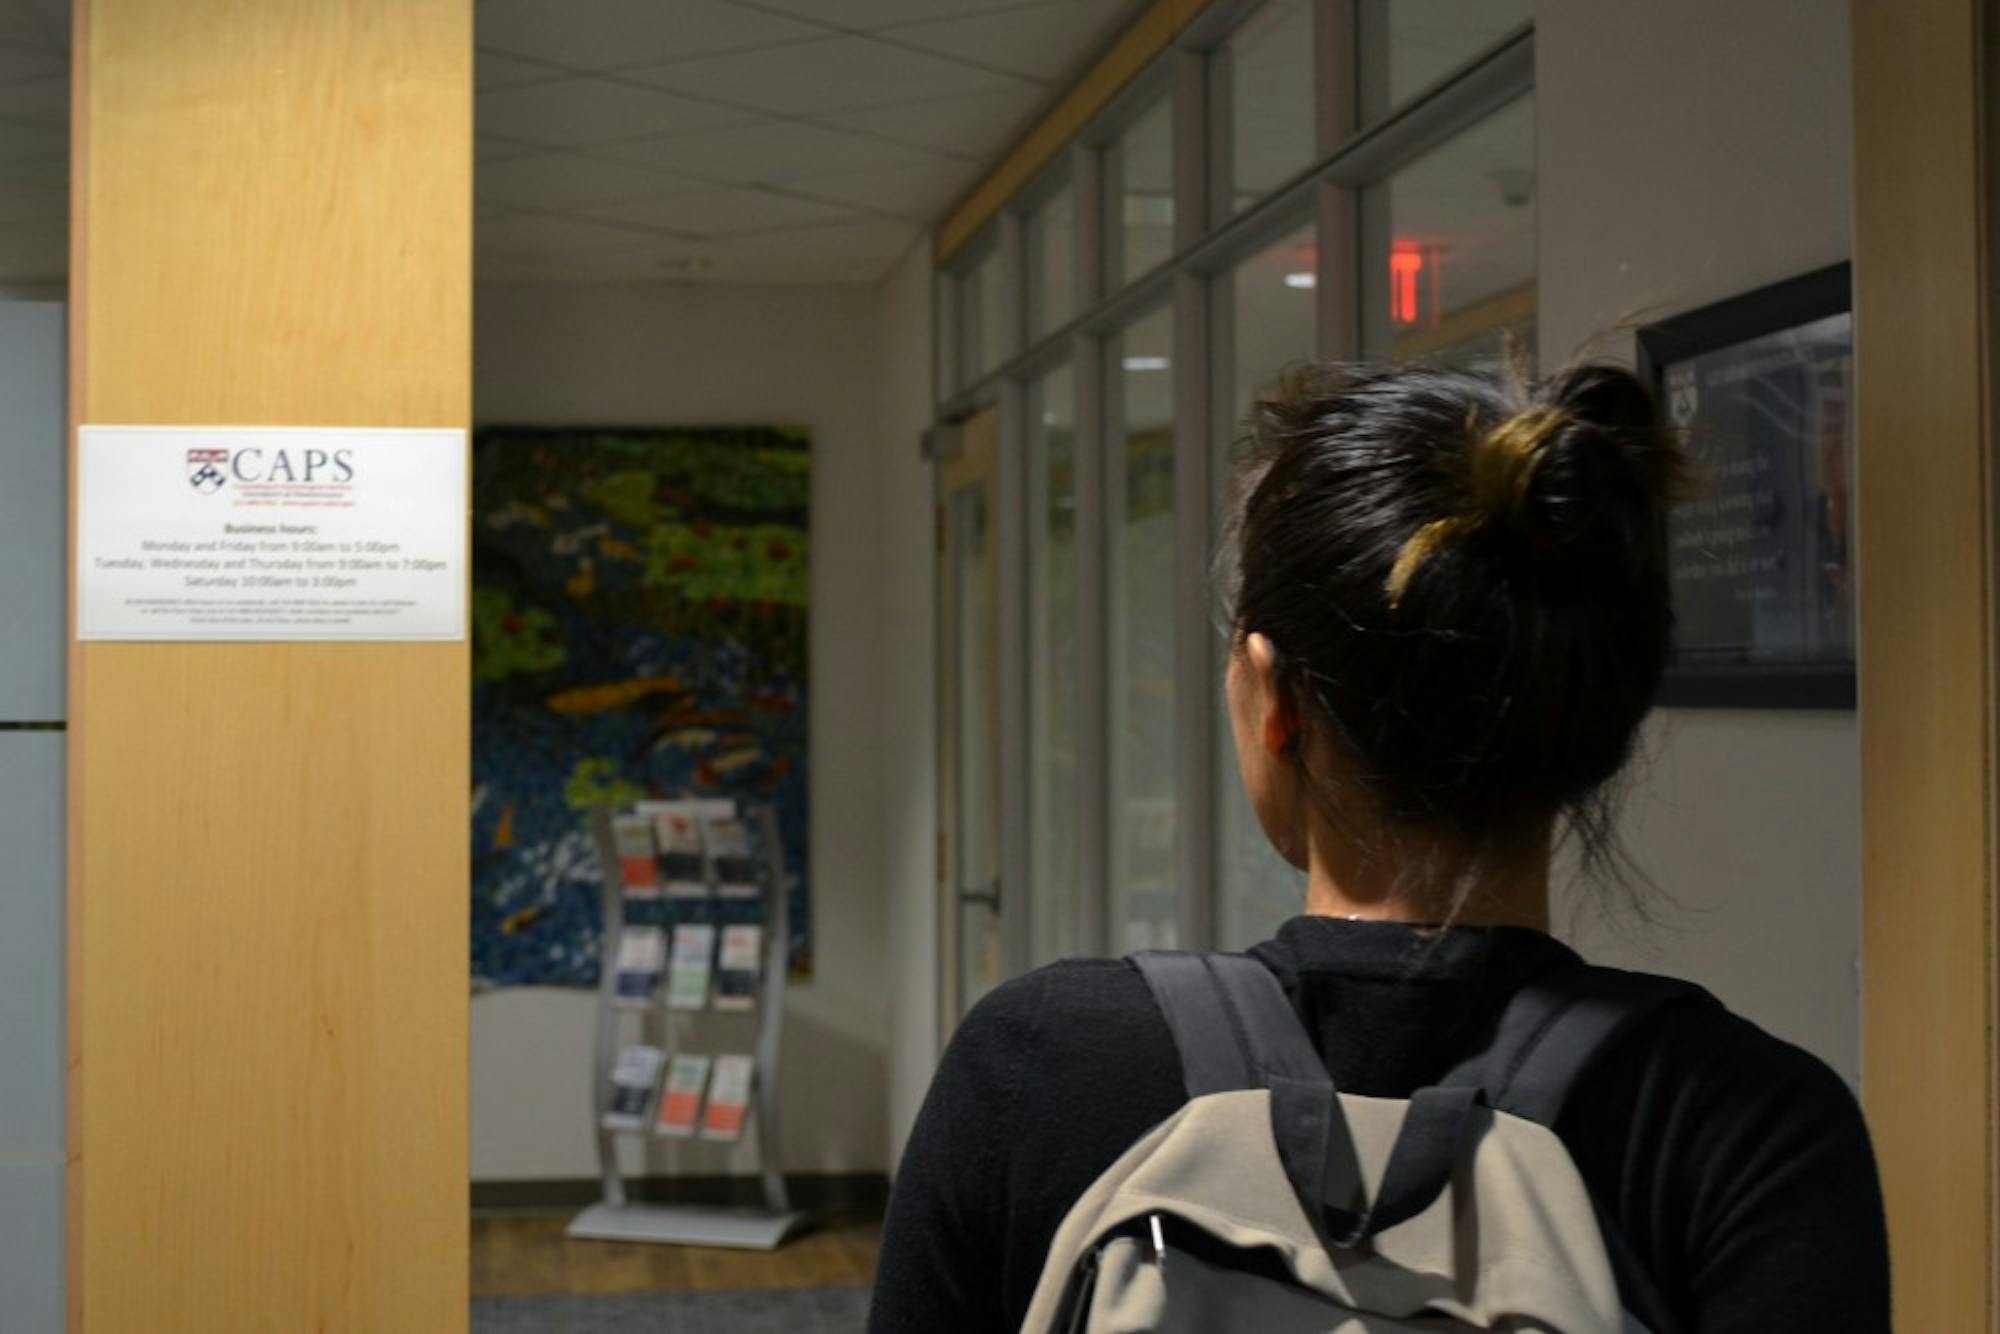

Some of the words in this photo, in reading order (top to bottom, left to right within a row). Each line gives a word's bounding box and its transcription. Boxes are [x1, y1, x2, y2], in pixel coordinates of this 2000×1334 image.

[232, 448, 354, 483] CAPS
[225, 523, 276, 535] Business
[142, 540, 191, 553] Monday
[194, 541, 217, 551] and
[220, 541, 257, 554] Friday
[259, 541, 288, 551] from
[151, 558, 220, 571] Wednesday
[224, 558, 246, 568] and
[249, 558, 303, 571] Thursday
[306, 558, 334, 569] from
[184, 575, 237, 589] Saturday
